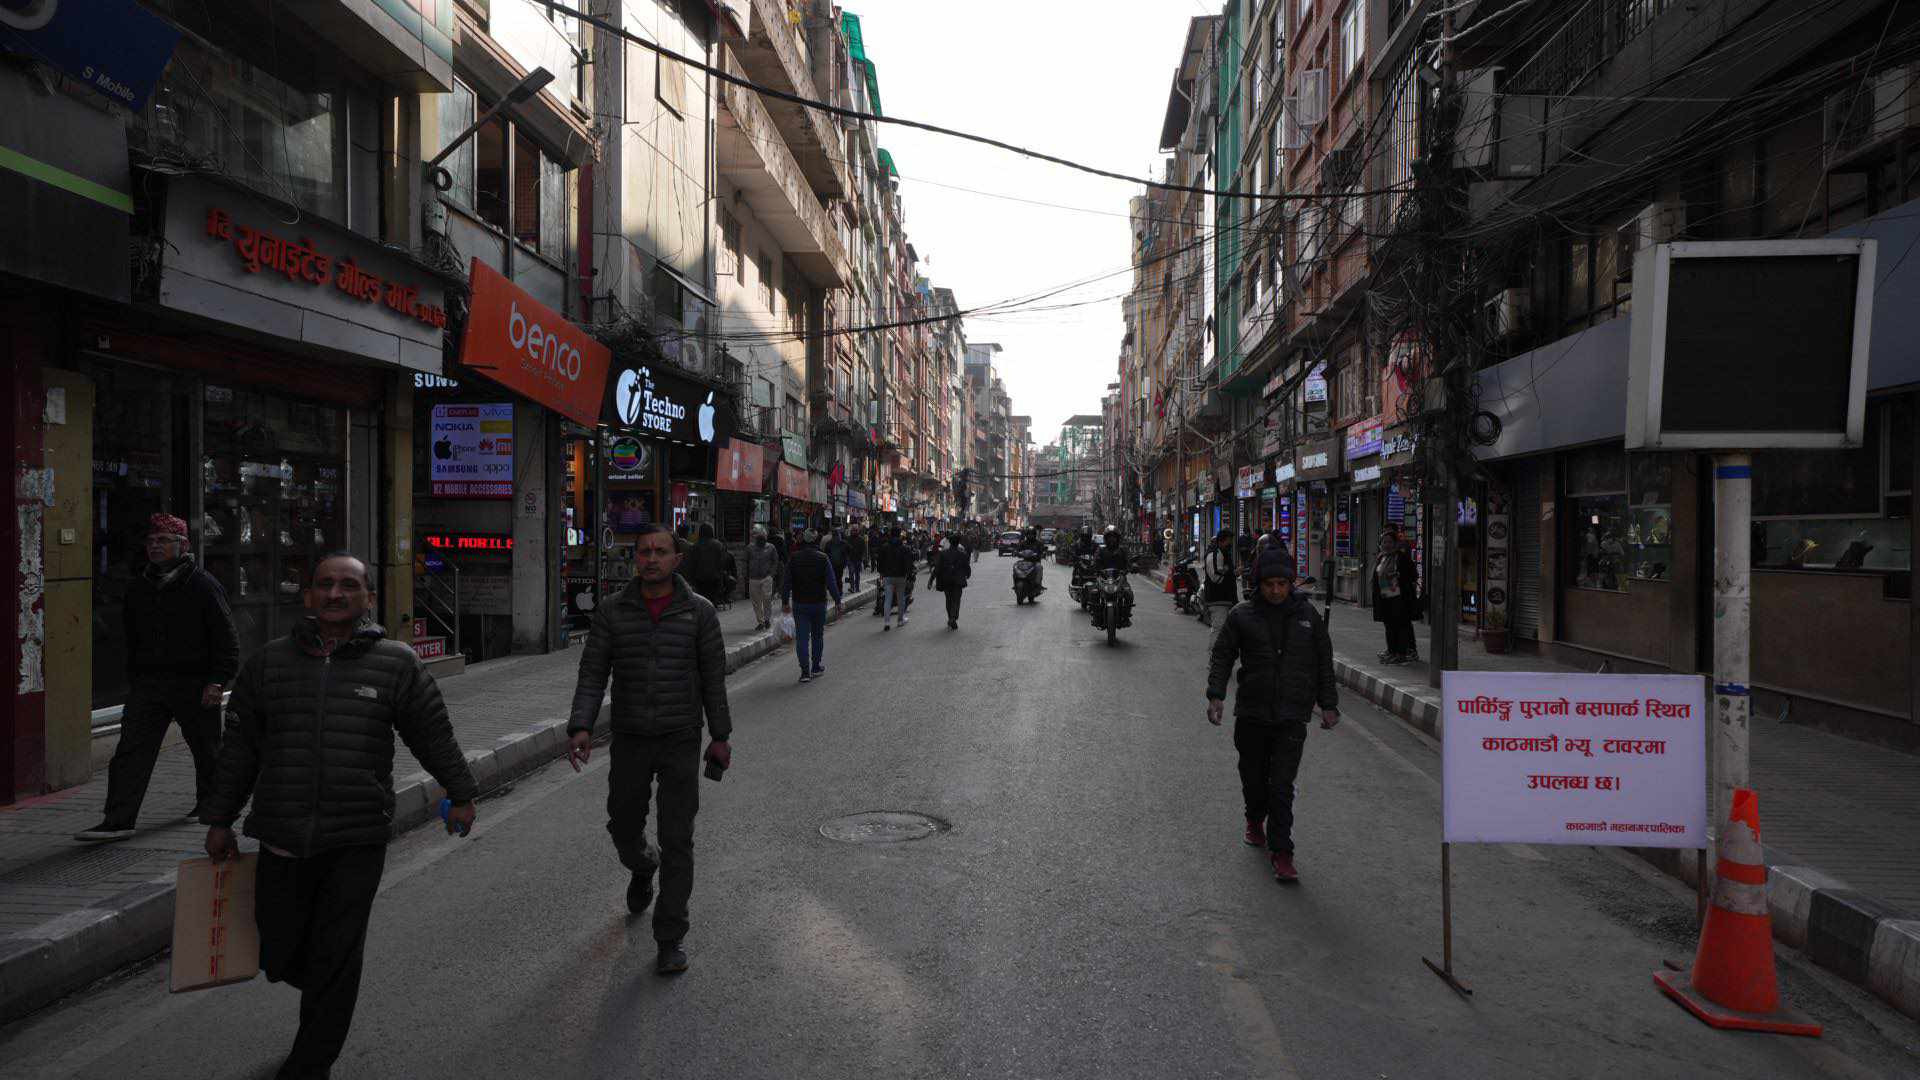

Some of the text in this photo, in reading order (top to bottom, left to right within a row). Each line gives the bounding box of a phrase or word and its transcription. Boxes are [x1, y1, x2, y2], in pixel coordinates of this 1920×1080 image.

[96, 72, 135, 101] Mobile
[509, 301, 582, 382] benco
[643, 390, 686, 420] Techno
[435, 423, 474, 432] NOKIA
[643, 414, 673, 433] STORE
[436, 464, 478, 474] SAMSUNG
[1519, 697, 1570, 719] पुरानो
[1575, 698, 1640, 717] बसपार्क
[1645, 698, 1691, 719] स्थित
[1603, 738, 1666, 755] टावरमा
[1527, 774, 1589, 790] उपलब्ध
